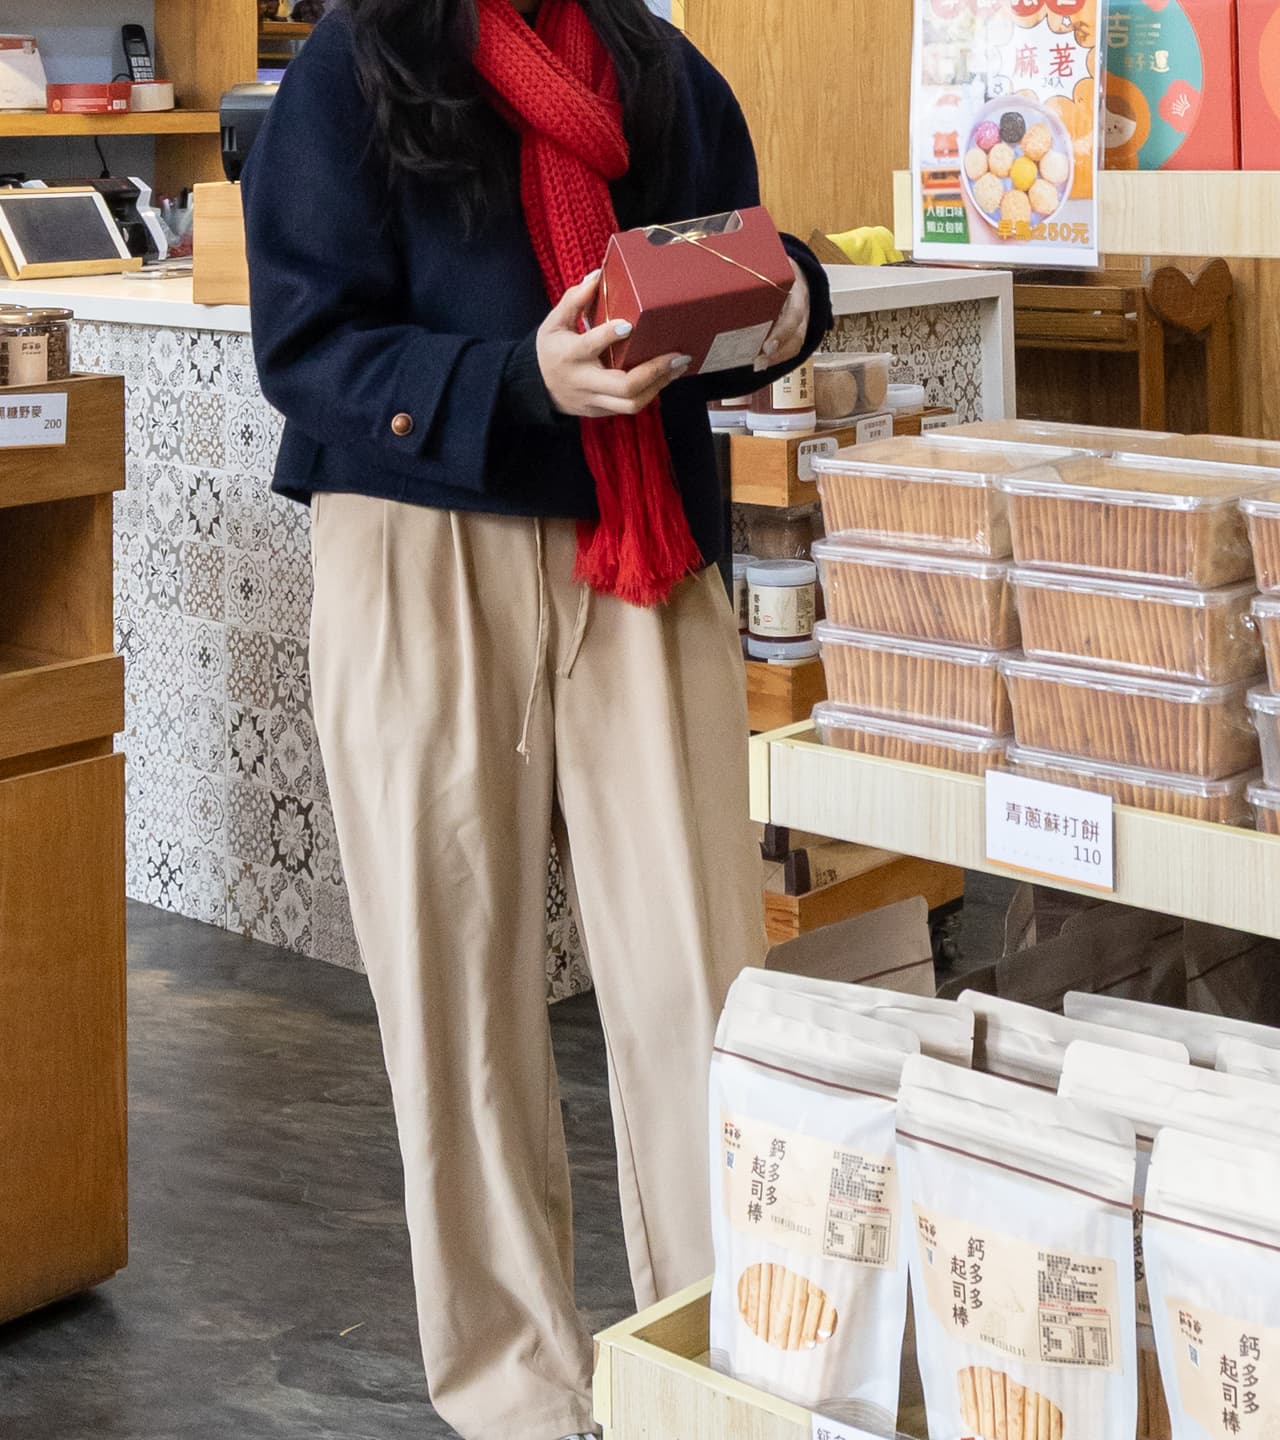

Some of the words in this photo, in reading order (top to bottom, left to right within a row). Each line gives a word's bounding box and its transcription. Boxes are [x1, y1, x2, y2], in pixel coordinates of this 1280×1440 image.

[1014, 42, 1078, 79] 麻荖
[43, 418, 62, 430] 200
[1003, 798, 1102, 845] 青蔥蘇打餅
[1072, 844, 1103, 867] 110
[745, 1153, 767, 1225] 起司棒
[763, 1136, 787, 1207] 鈣多多
[949, 1254, 971, 1330] 起司棒
[965, 1235, 987, 1312] 鈣多多
[1218, 1356, 1242, 1437] 起司棒
[1237, 1331, 1263, 1416] 鈣多多
